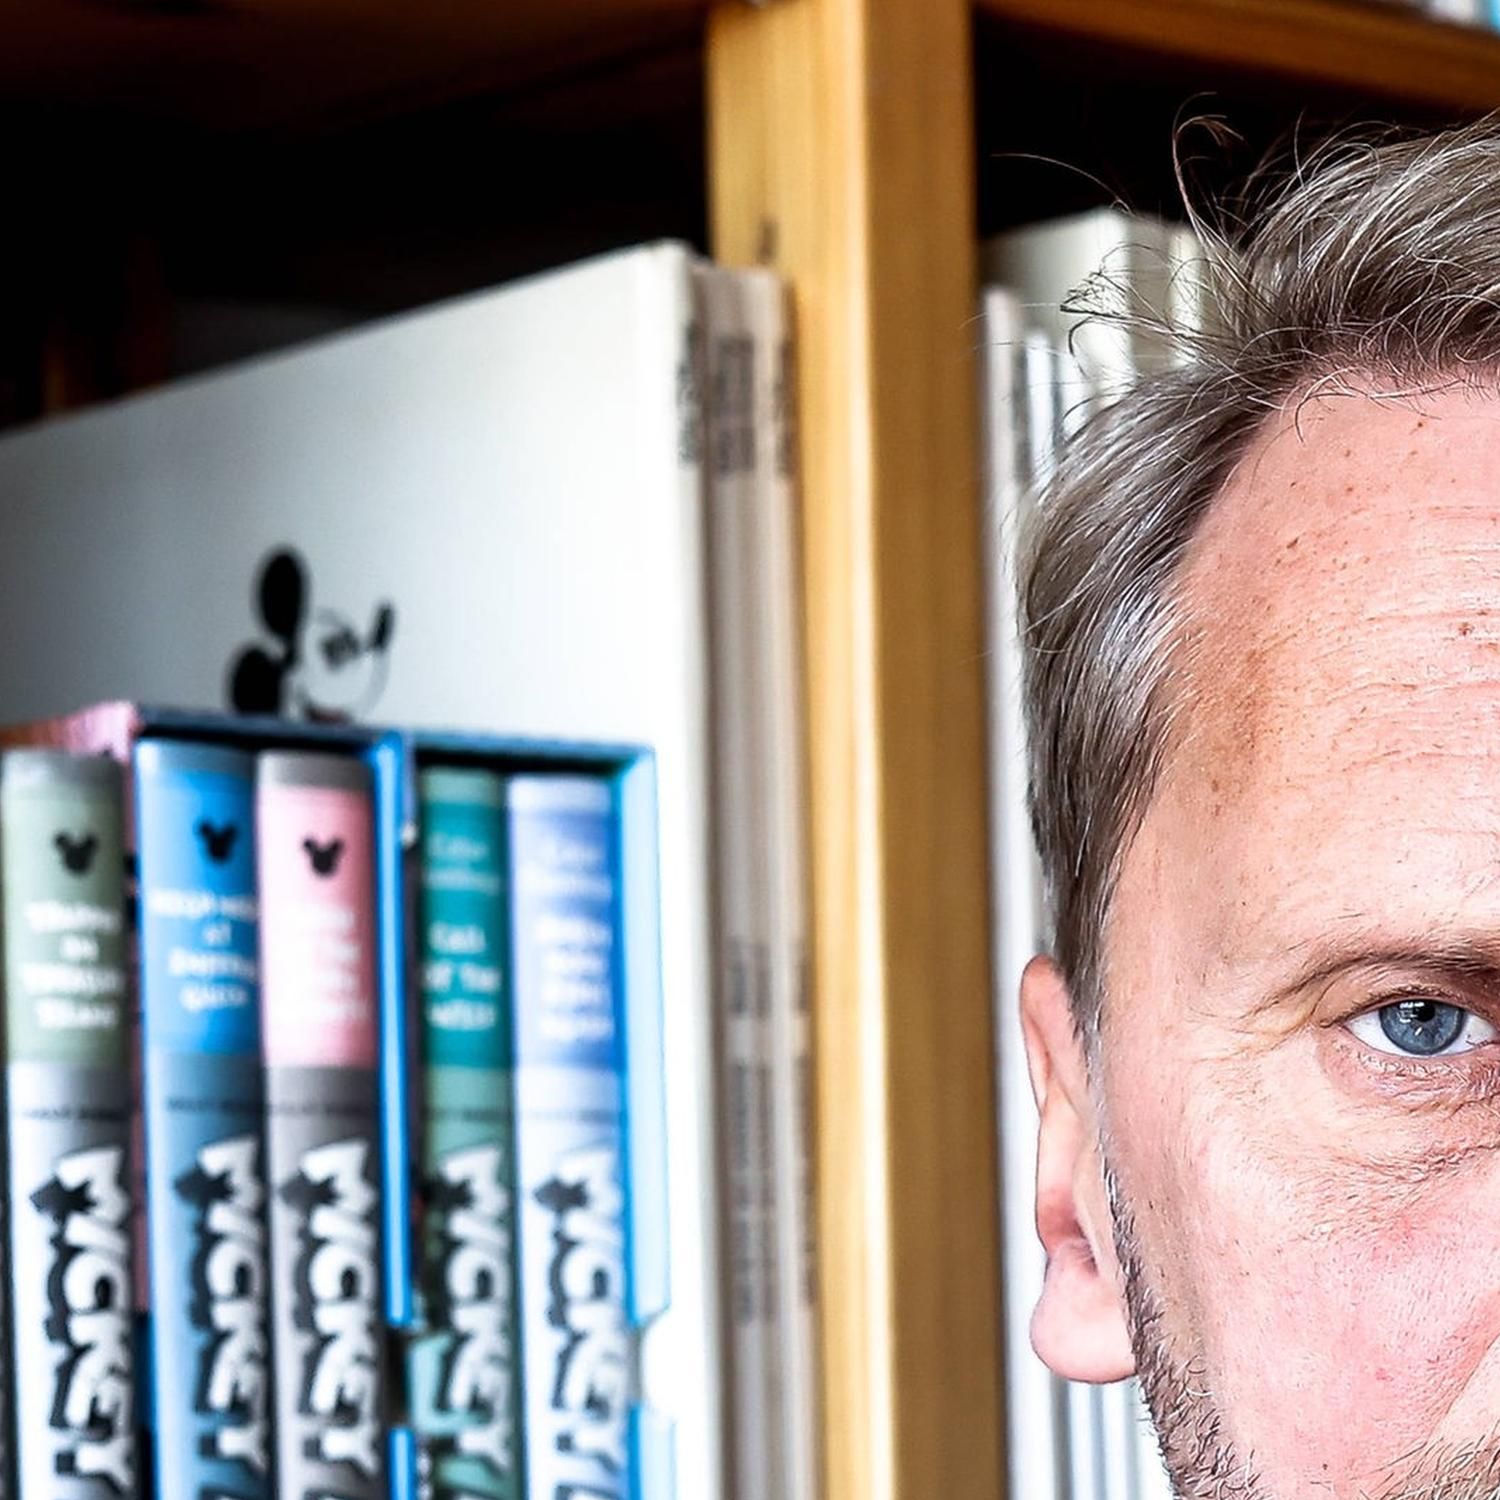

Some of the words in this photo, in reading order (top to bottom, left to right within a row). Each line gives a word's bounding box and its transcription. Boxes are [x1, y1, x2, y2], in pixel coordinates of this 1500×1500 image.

[54, 1147, 132, 1494] MICKEY
[198, 1134, 268, 1473] MICKEY
[301, 1138, 378, 1477] MICKEY
[441, 1146, 511, 1470] MICKEY
[557, 1146, 628, 1473] MICKEY
